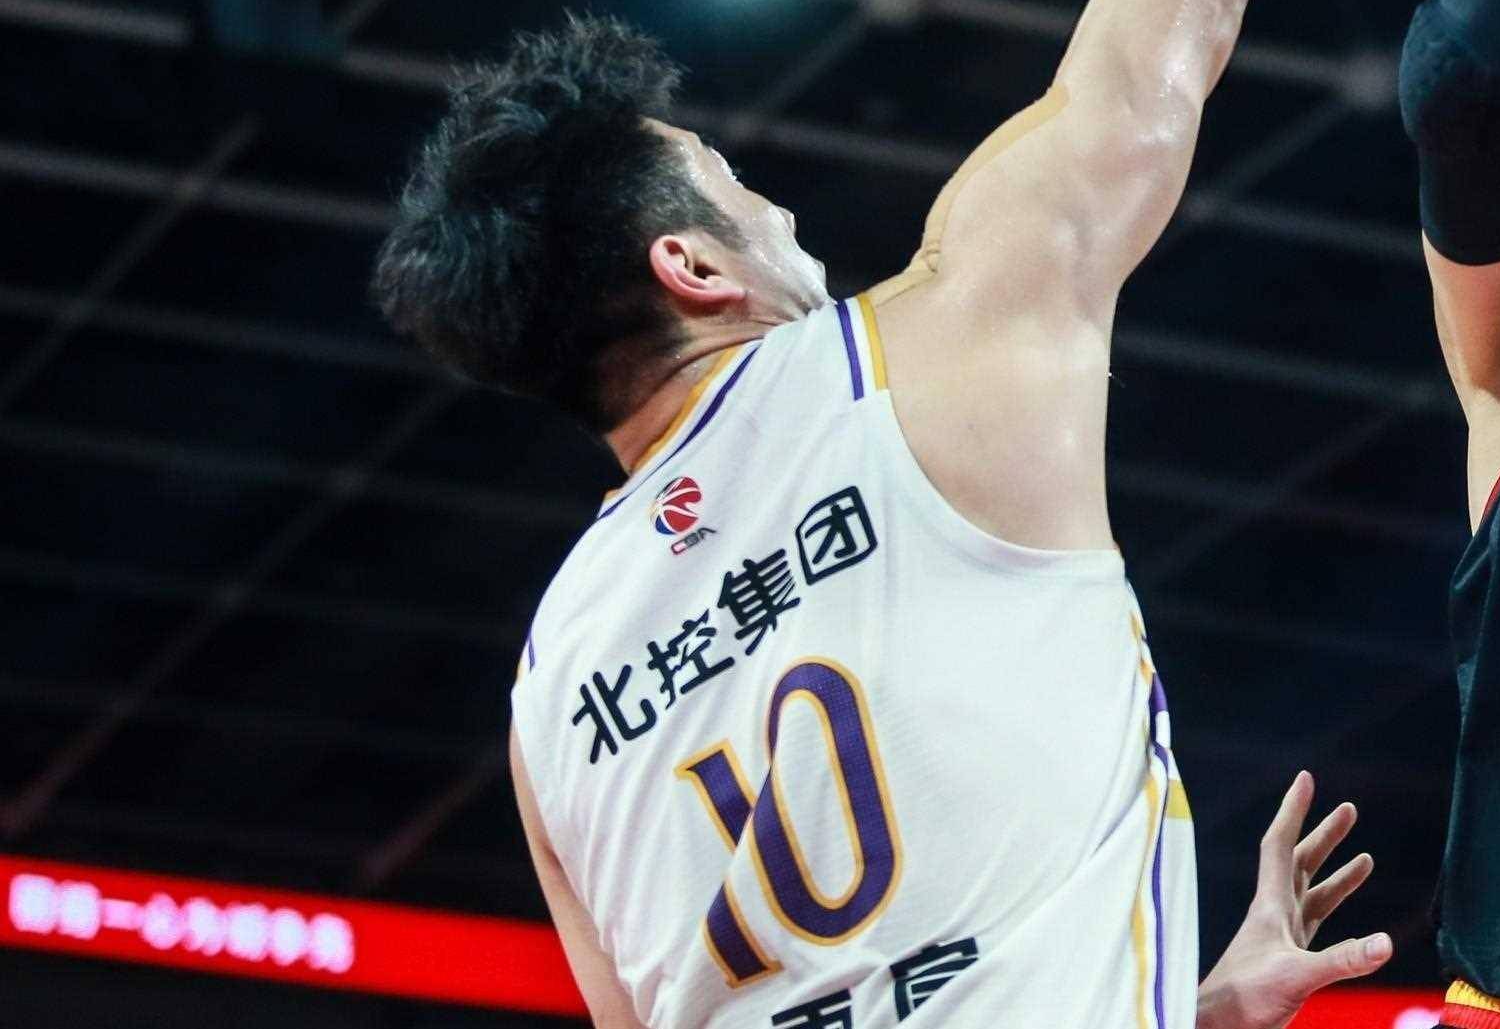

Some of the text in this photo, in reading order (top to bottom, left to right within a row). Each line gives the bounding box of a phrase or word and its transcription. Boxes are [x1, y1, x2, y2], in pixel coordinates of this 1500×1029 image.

[571, 485, 878, 764] 北控集团
[674, 656, 903, 989] 10
